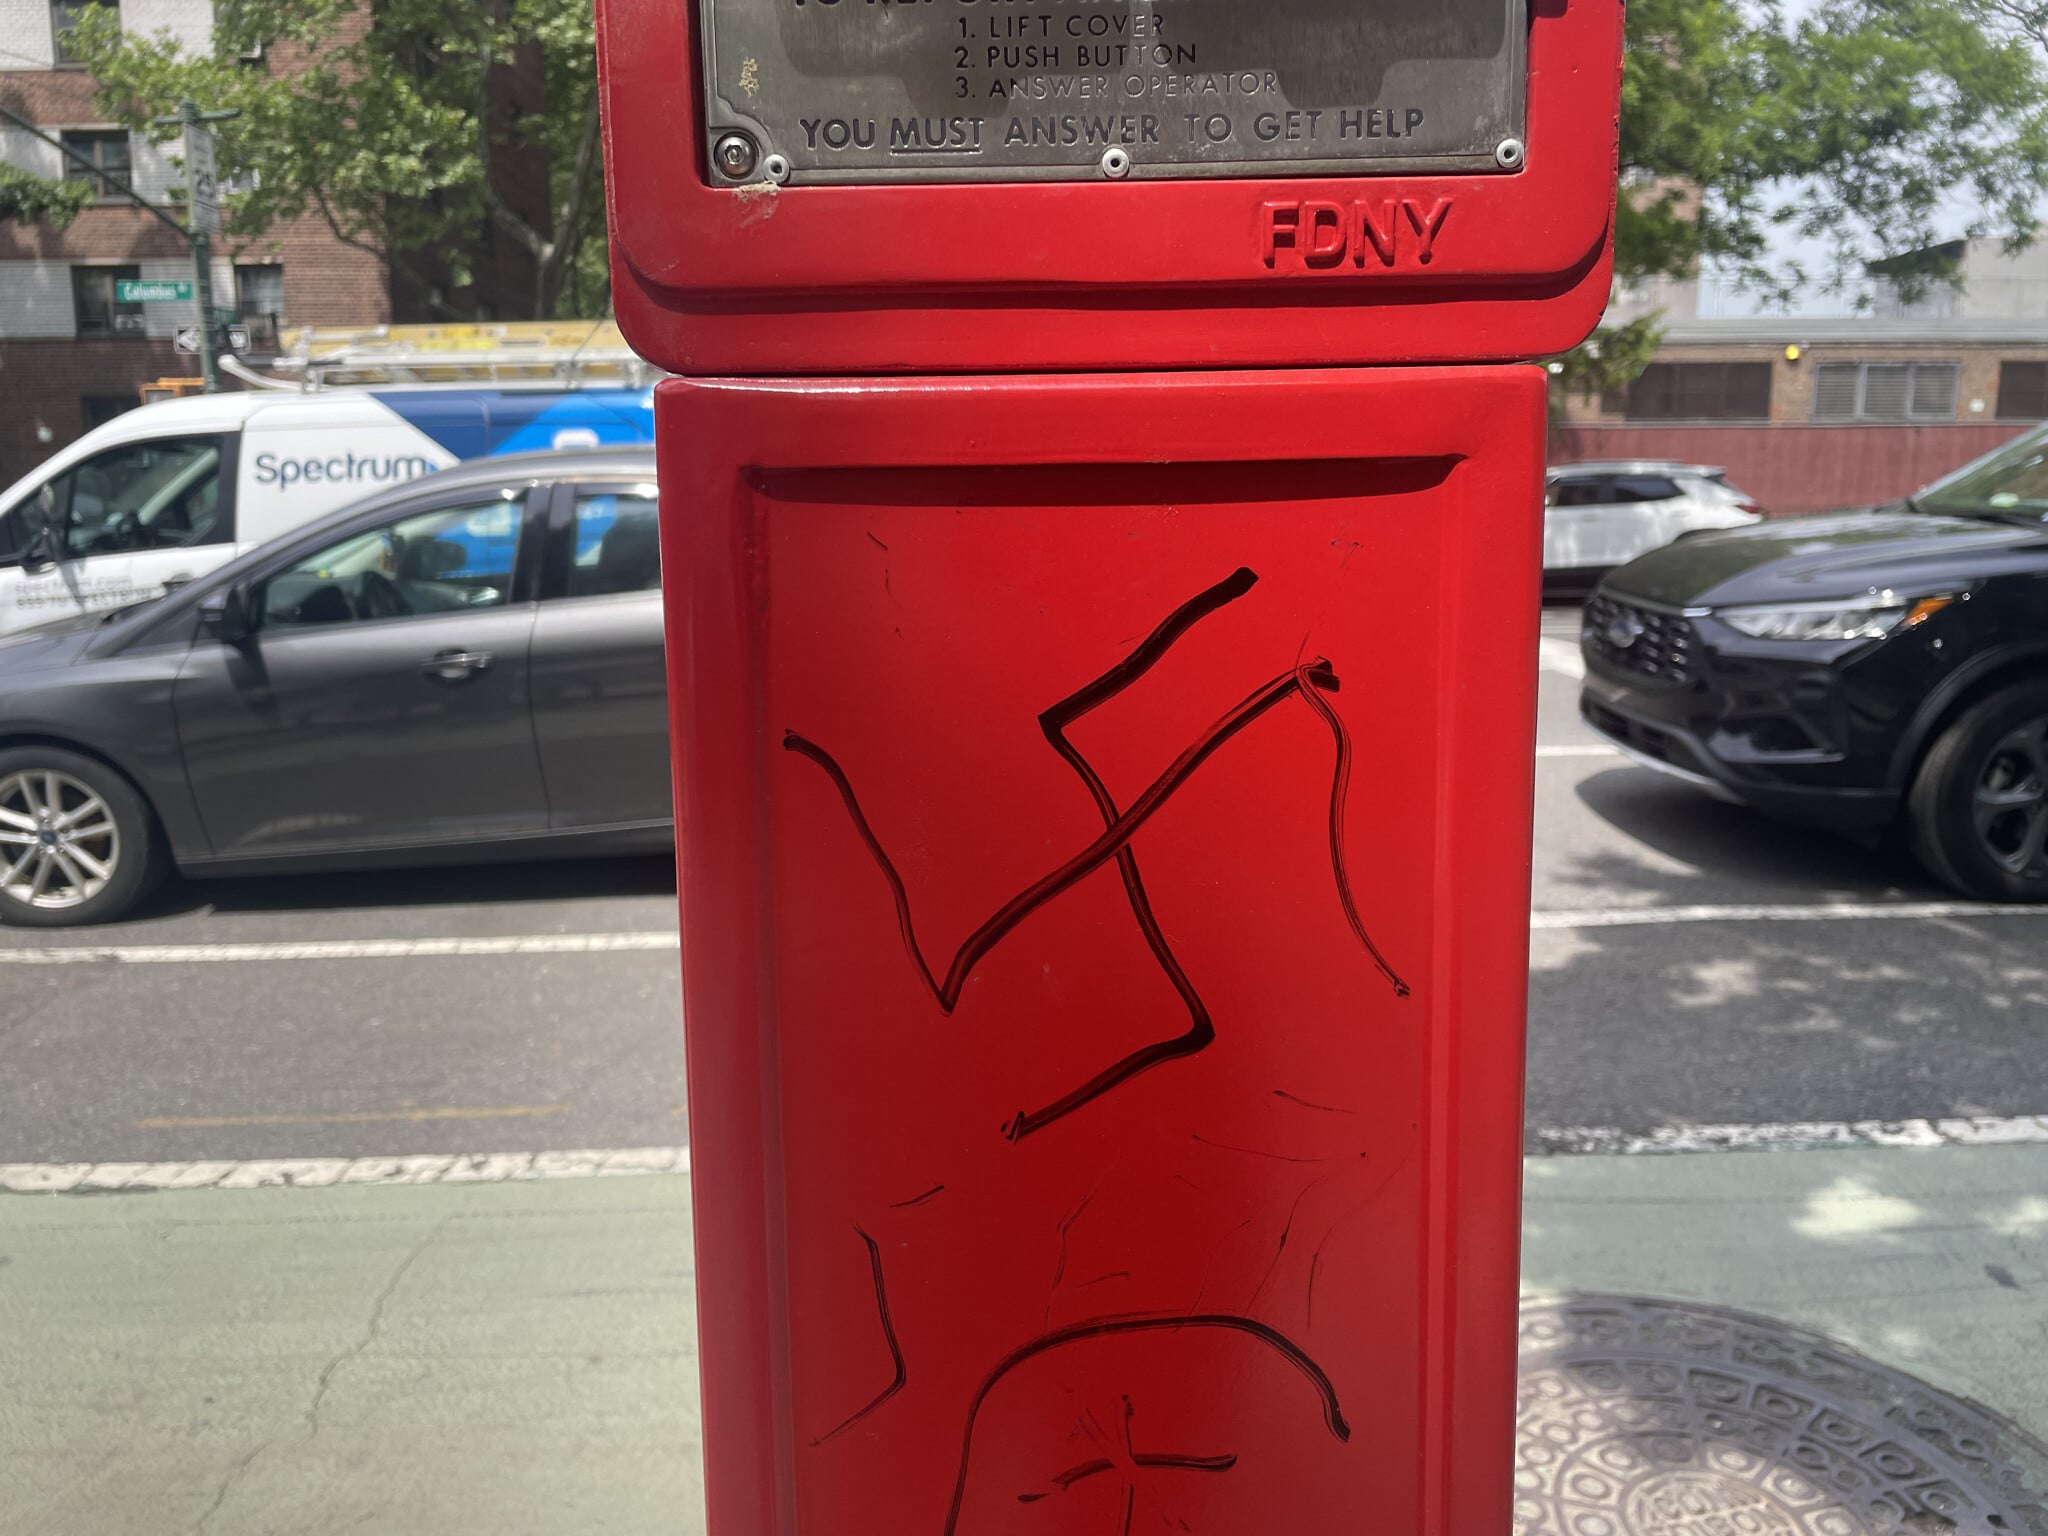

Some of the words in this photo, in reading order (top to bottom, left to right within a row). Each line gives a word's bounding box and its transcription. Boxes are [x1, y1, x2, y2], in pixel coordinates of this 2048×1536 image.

[958, 17, 976, 38] 1.
[989, 16, 1052, 38] LIFT
[1066, 14, 1164, 37] COVER
[954, 46, 976, 68] 2.
[987, 45, 1059, 68] PUSH
[1077, 43, 1197, 67] BUTTON
[955, 77, 976, 98] 3.
[988, 74, 1108, 99] ANSWER
[1125, 71, 1278, 98] OPERATOR
[800, 118, 875, 150] YOU
[890, 117, 985, 149] MUST
[1004, 113, 1159, 147] ANSWER
[1185, 112, 1233, 143] TO
[1254, 110, 1322, 142] GET
[1340, 108, 1425, 140] HELP
[1263, 199, 1453, 269] FDNY
[255, 450, 428, 491] Spectrum
